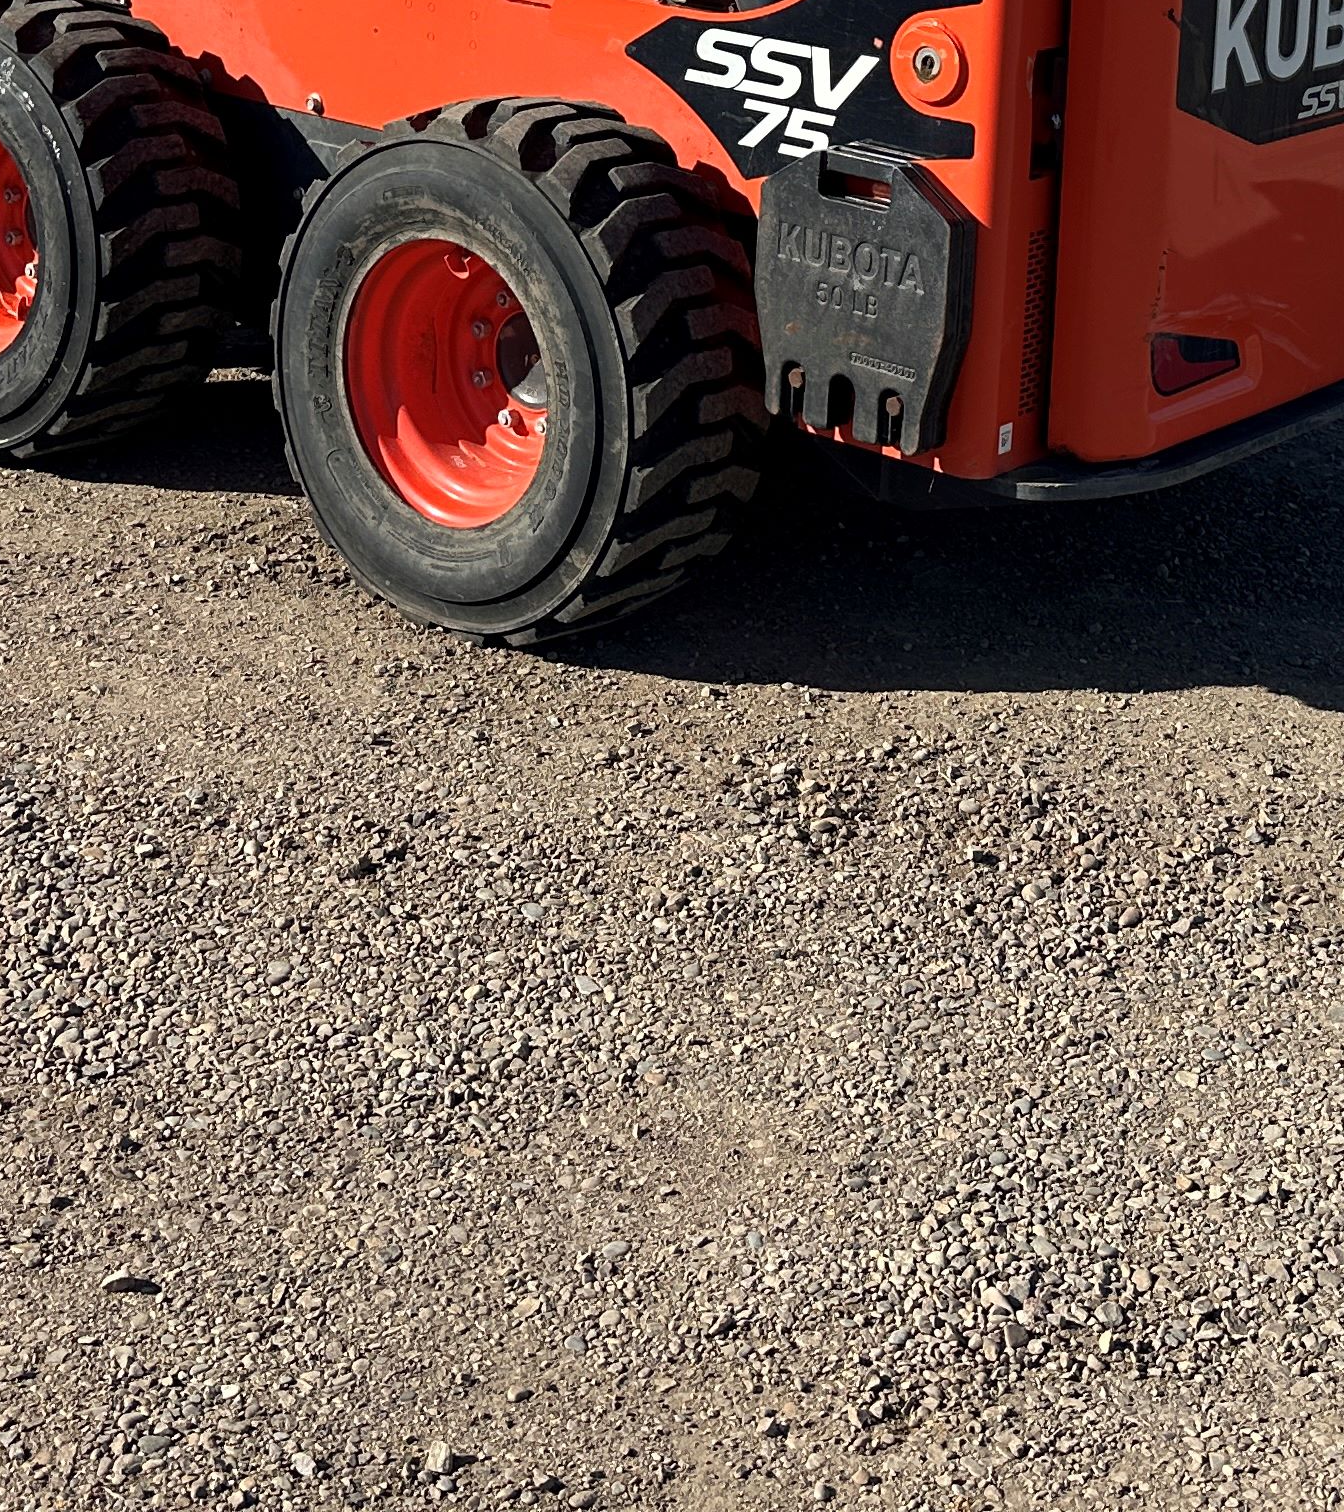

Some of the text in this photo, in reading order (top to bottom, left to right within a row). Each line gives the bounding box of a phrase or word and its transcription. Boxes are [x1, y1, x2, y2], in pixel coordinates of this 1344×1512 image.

[684, 28, 881, 111] SSV
[737, 98, 837, 158] 75
[777, 221, 925, 296] KUBOTA
[816, 280, 878, 319] 50 LB
